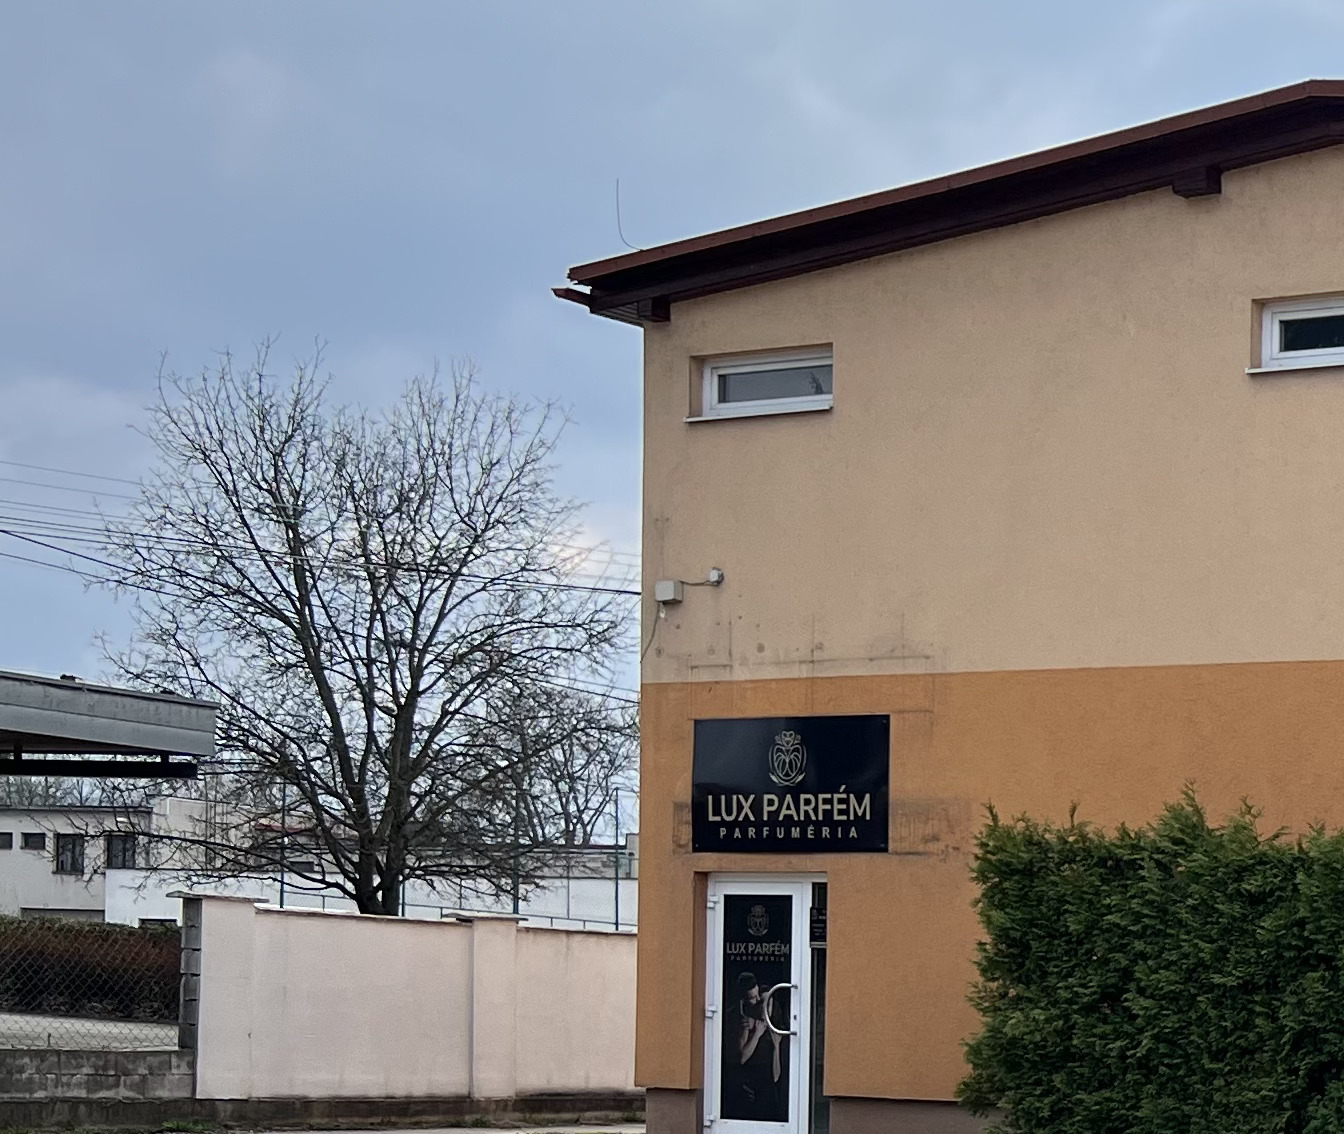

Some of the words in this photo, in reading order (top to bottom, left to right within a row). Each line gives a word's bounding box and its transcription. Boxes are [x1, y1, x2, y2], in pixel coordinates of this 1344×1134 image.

[708, 794, 755, 821] LUX
[763, 785, 871, 821] PARFÉM
[719, 825, 858, 839] PARFUMÉRIA
[726, 942, 746, 954] LUX
[748, 940, 790, 955] PARFÉM
